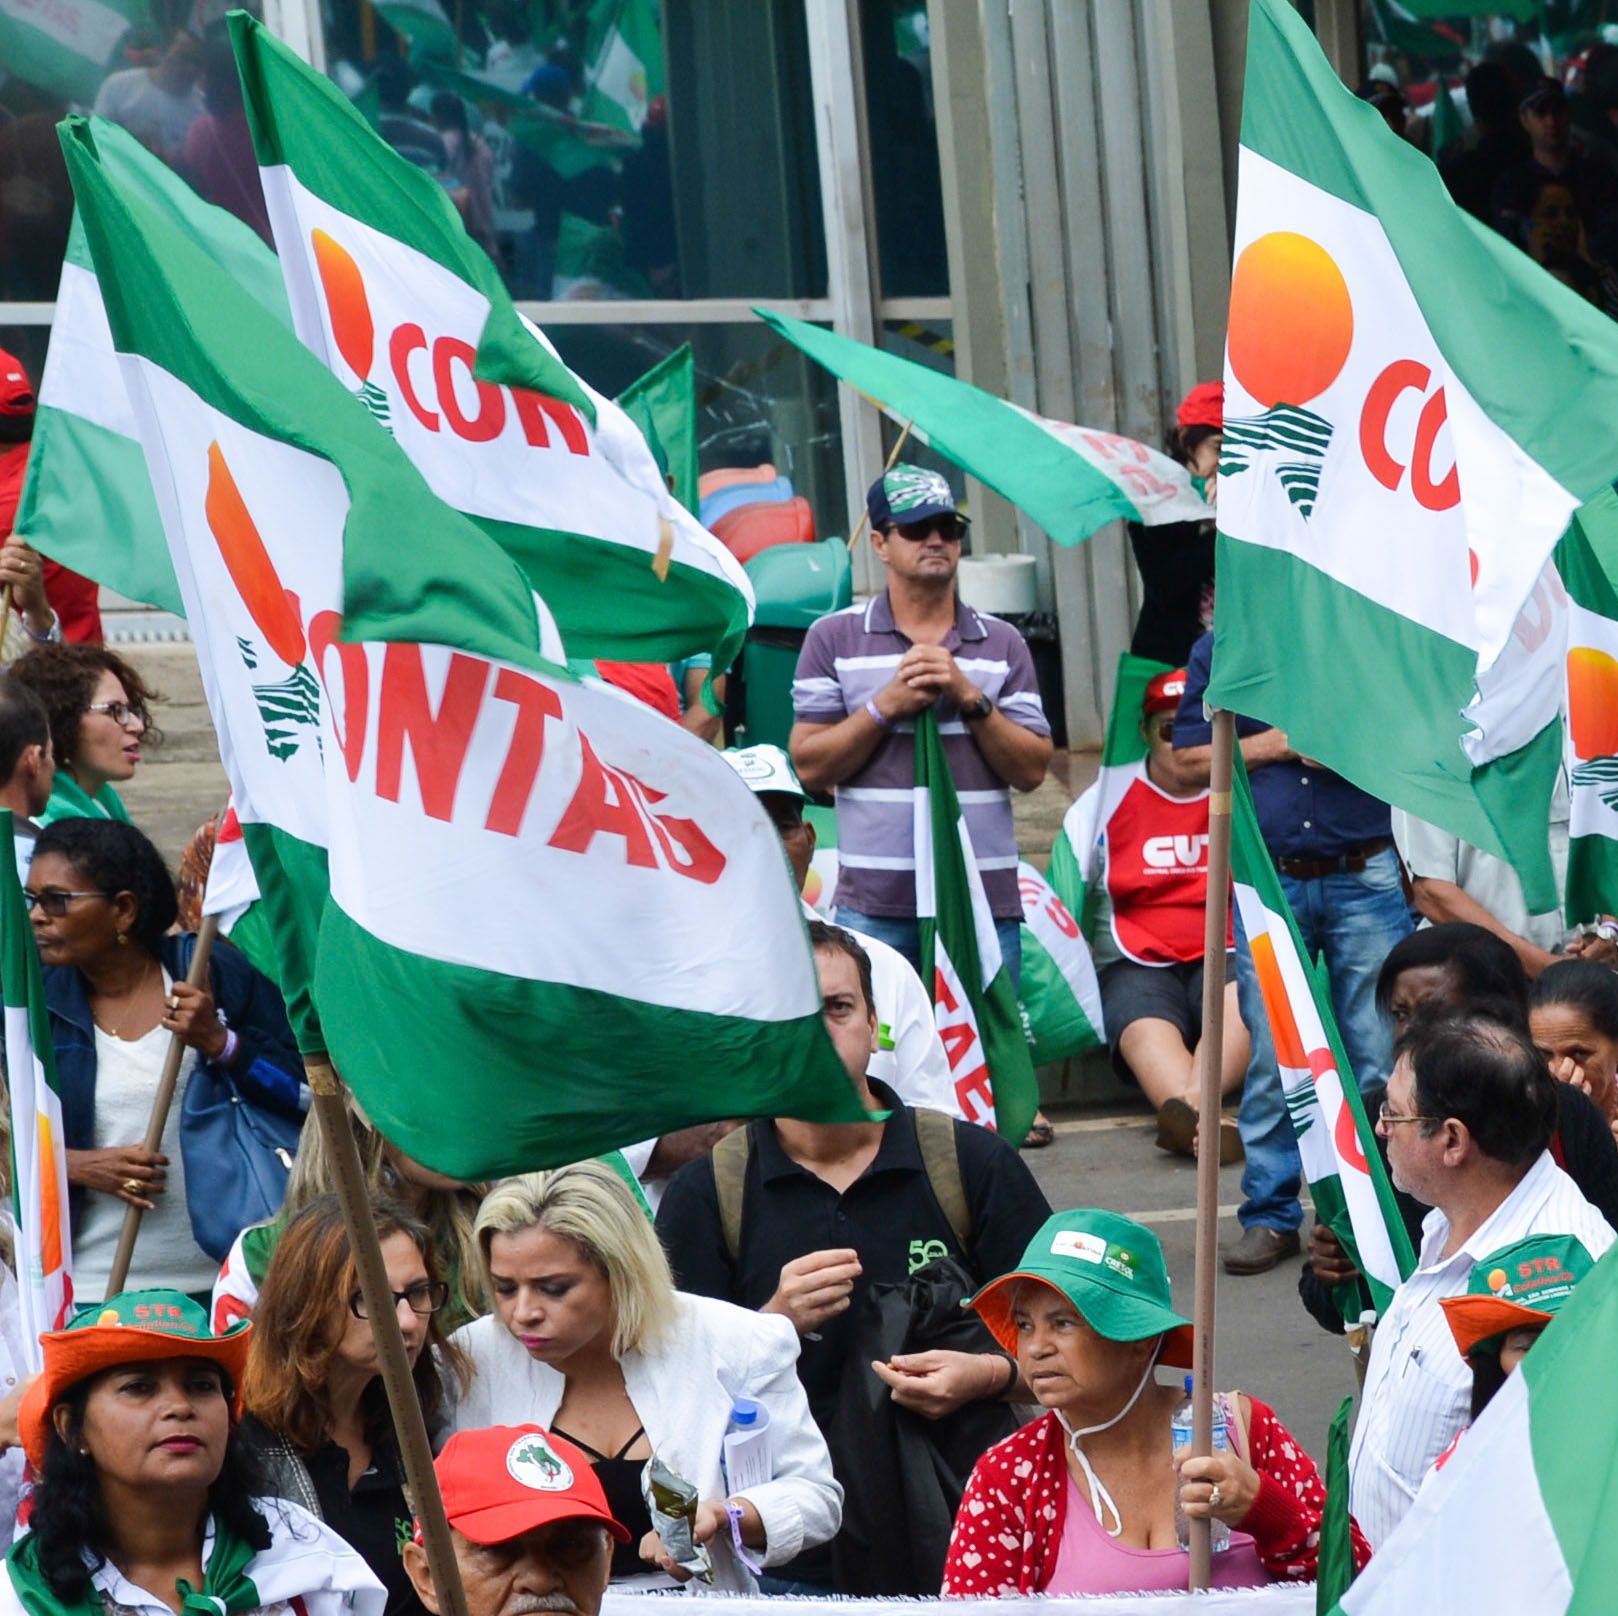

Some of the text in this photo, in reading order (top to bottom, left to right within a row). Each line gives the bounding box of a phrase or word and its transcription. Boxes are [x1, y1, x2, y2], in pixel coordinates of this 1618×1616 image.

[285, 590, 727, 884] ONTAG
[1517, 1257, 1561, 1278] STR
[135, 1303, 182, 1319] STR
